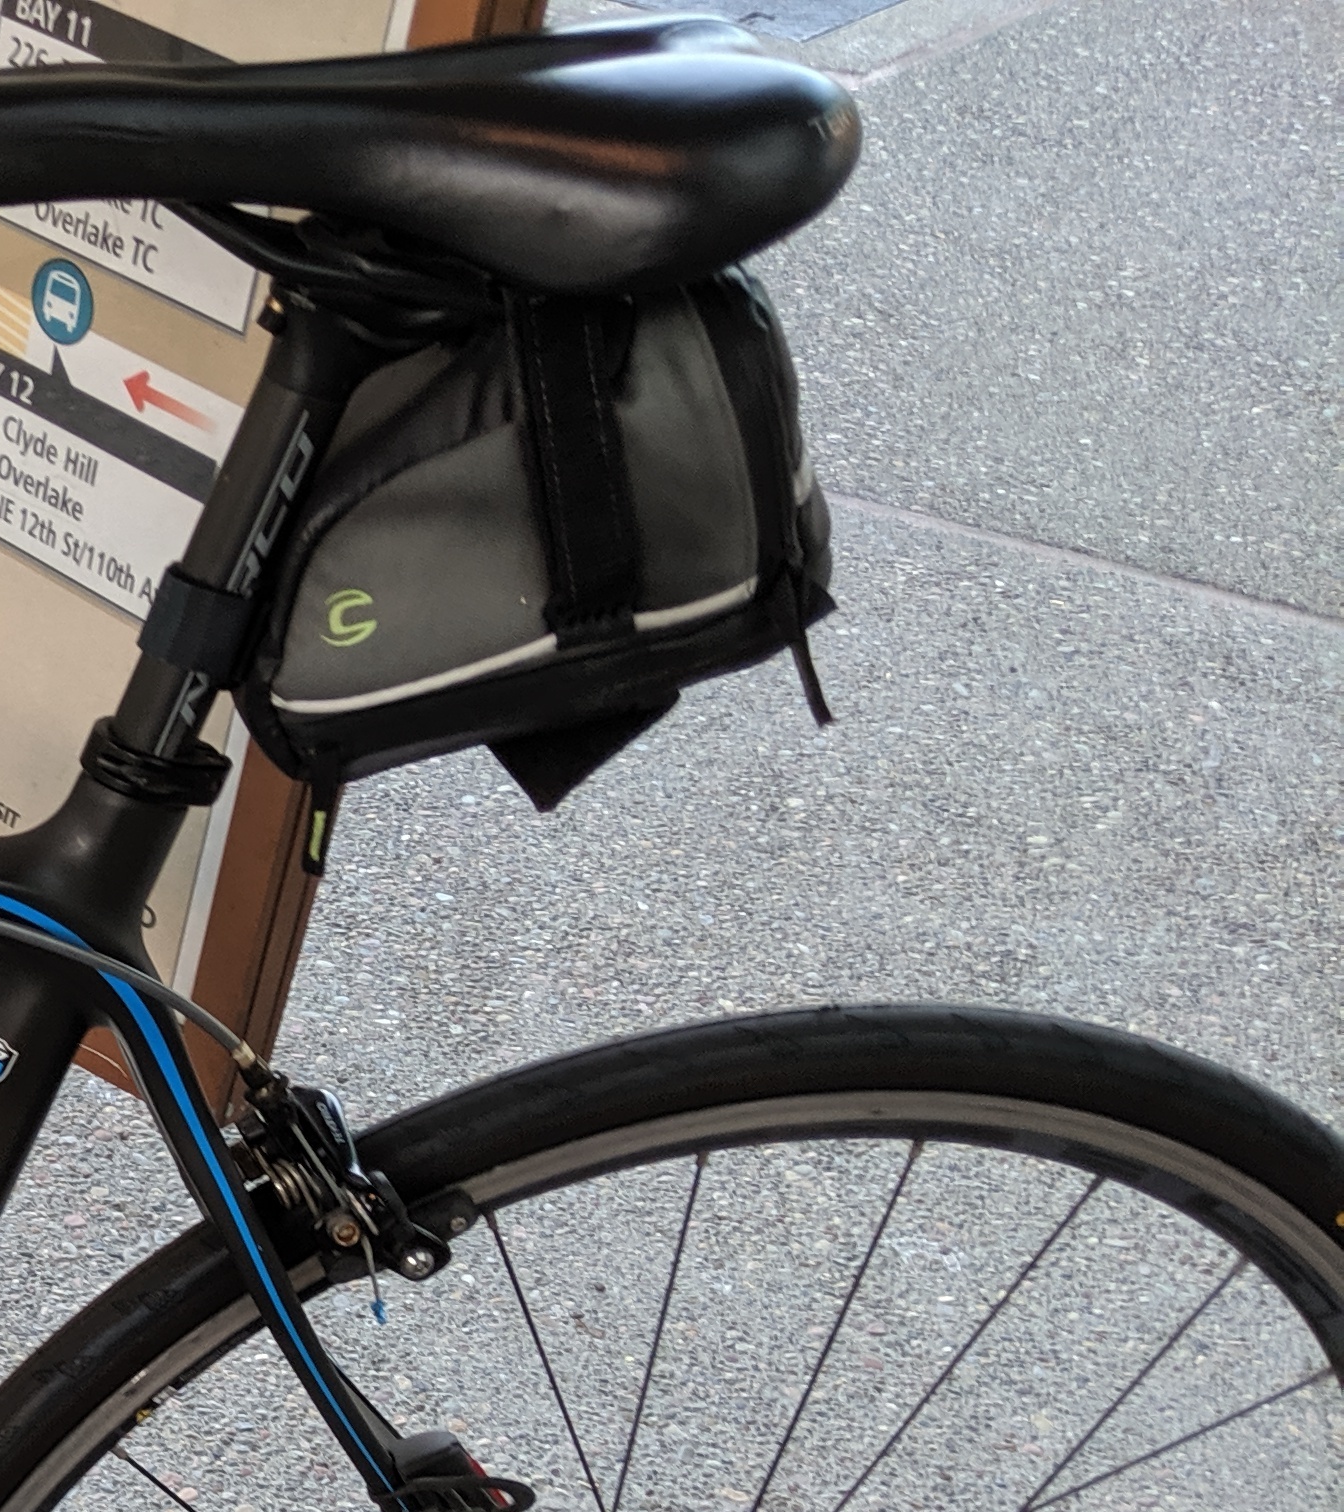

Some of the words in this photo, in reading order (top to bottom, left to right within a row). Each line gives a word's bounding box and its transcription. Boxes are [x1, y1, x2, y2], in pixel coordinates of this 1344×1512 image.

[15, 0, 63, 33] BAY
[67, 10, 92, 48] 11
[34, 201, 125, 258] Overlake
[133, 236, 159, 274] TC
[10, 370, 36, 405] 12
[2, 415, 59, 466] Clyde
[64, 446, 99, 487] Hill
[20, 507, 57, 549] 12th
[62, 531, 136, 596] St/110th
[178, 429, 314, 729] NRCO
